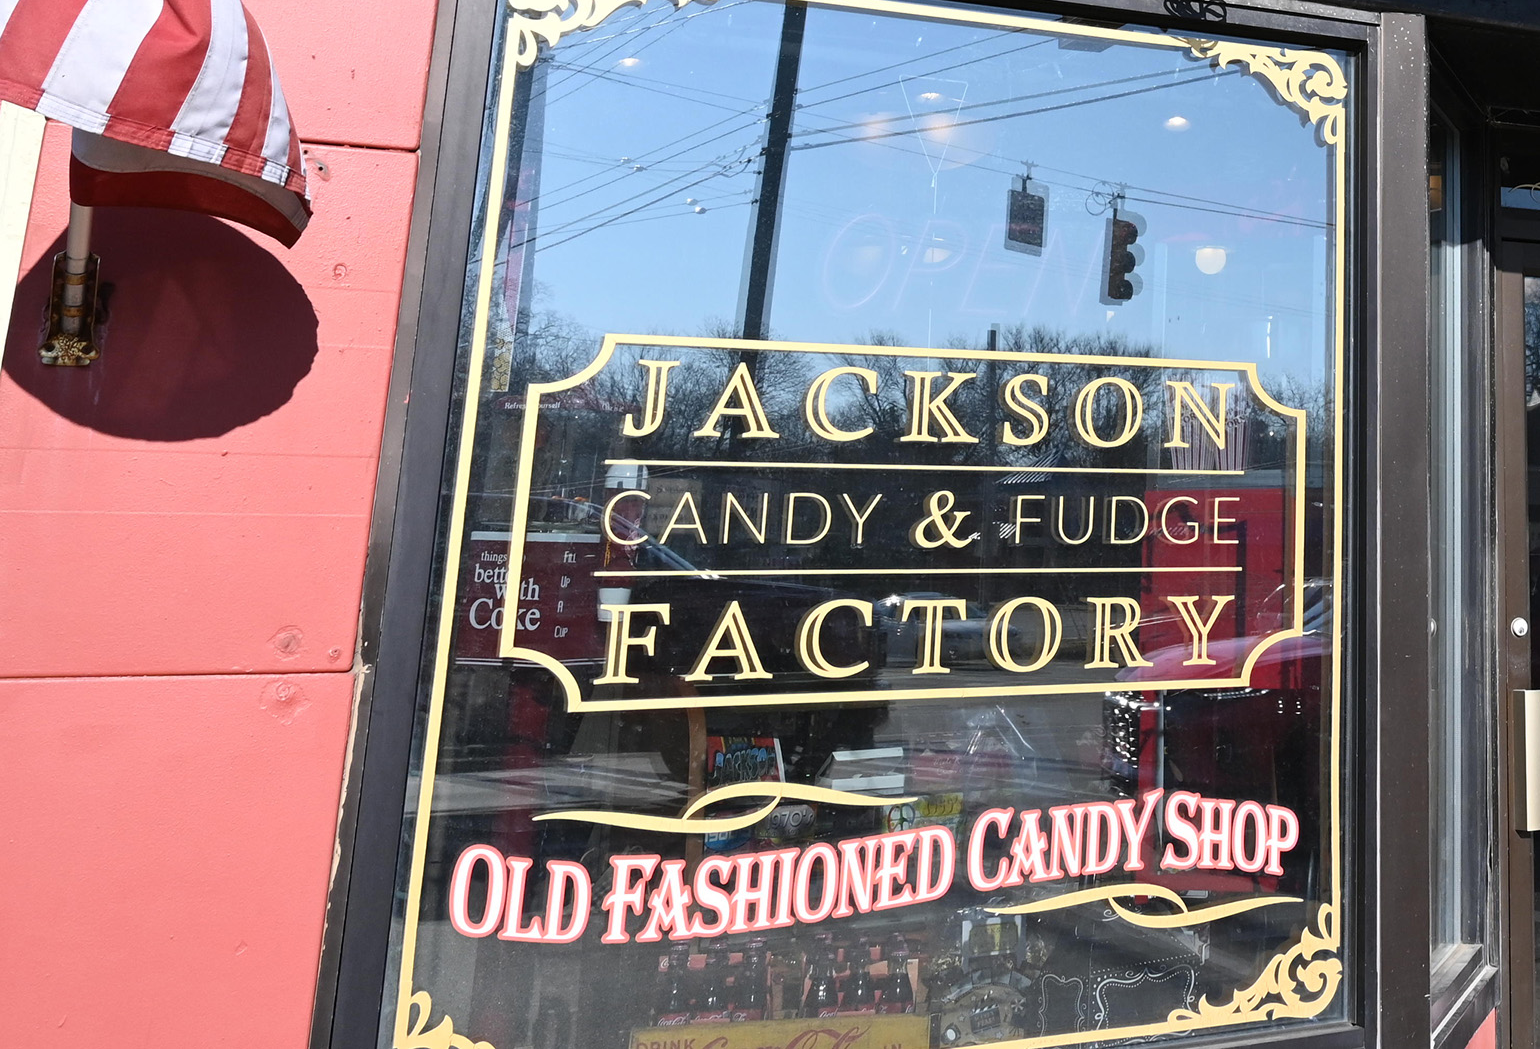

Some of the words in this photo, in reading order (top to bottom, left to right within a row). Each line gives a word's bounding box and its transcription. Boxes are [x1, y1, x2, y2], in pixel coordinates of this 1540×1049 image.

[624, 360, 1235, 449] JACKSON
[604, 490, 882, 547] CANDY
[914, 490, 971, 549] &
[1015, 495, 1241, 546] FUDGE
[495, 579, 540, 601] wth
[594, 594, 1236, 686] FACTORY
[449, 843, 591, 944] OLD
[602, 824, 955, 944] FASHIONED
[968, 788, 1165, 891] CANDY
[1162, 792, 1300, 877] SHOP
